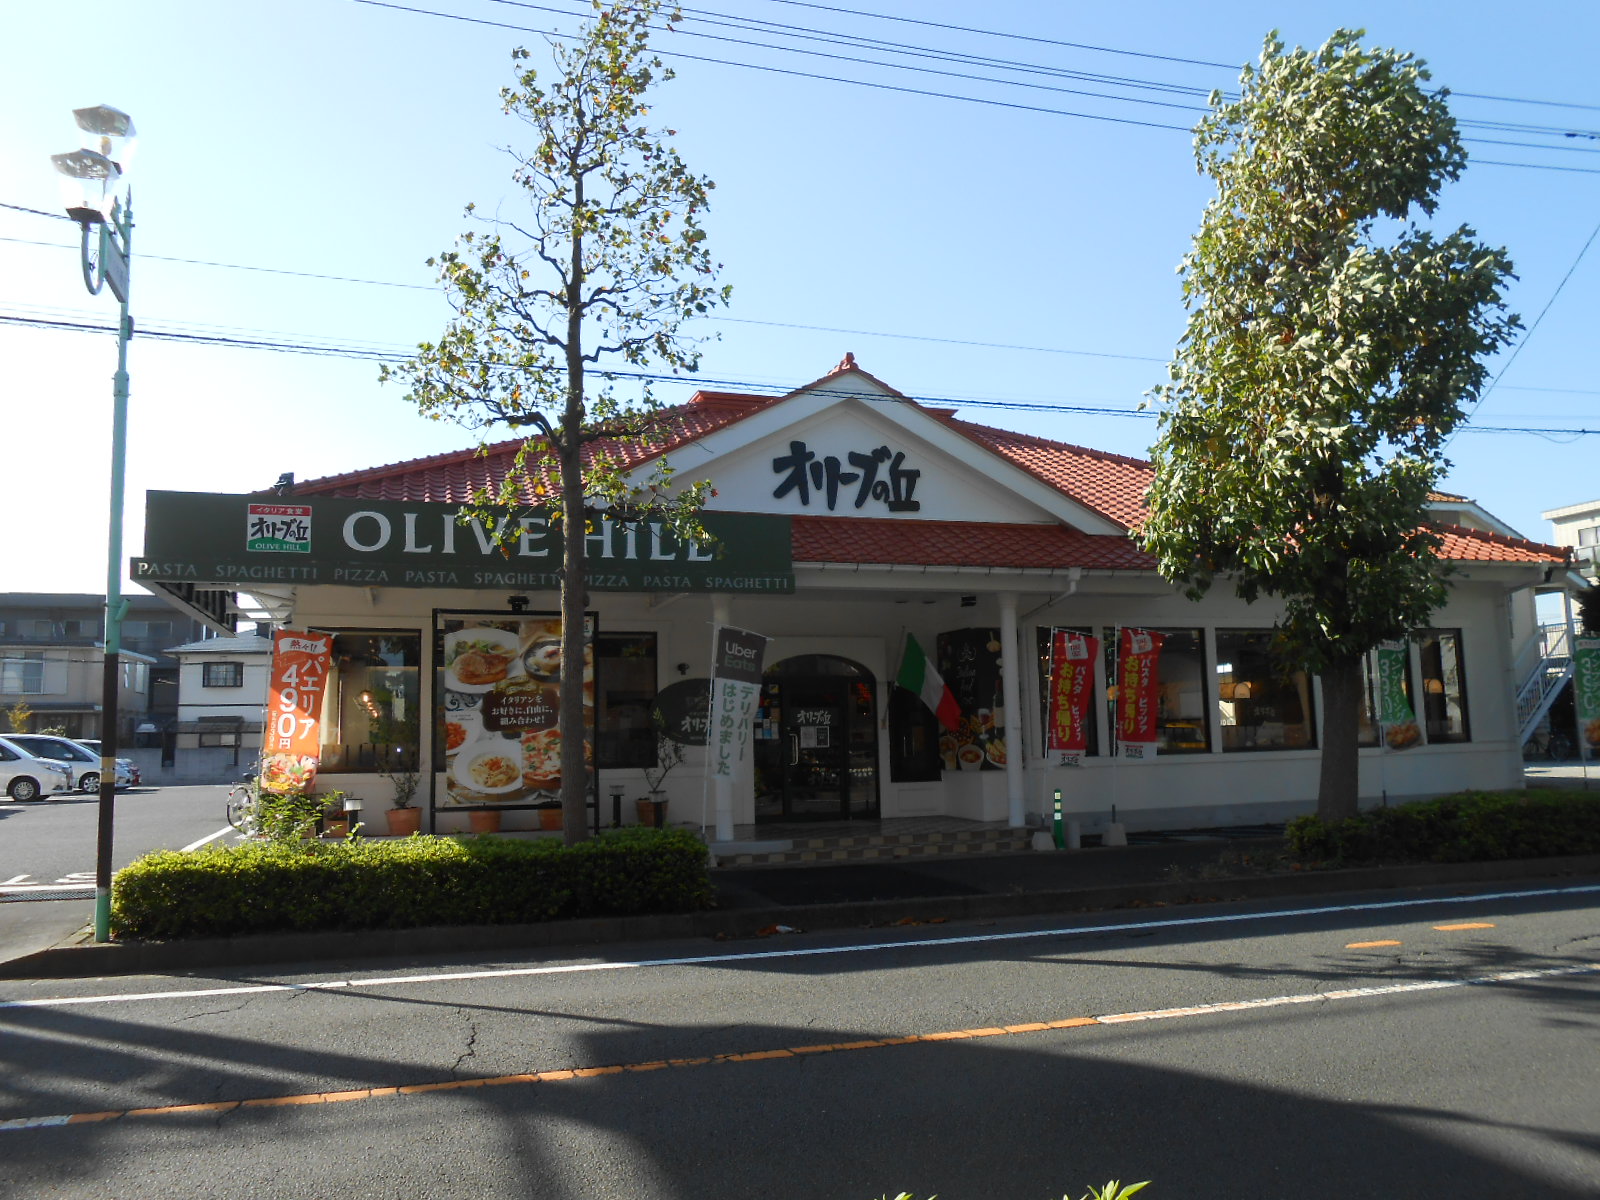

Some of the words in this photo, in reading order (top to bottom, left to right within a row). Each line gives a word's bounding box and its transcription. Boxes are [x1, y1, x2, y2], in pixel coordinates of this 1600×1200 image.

[773, 440, 921, 512] オリーブの丘
[250, 517, 309, 541] オリーブの丘
[342, 511, 549, 557] OLIVE
[255, 542, 280, 550] OLIVE
[137, 562, 197, 577] PASTA
[215, 565, 317, 580] SPAGHETTI
[334, 568, 390, 583] PIZZA
[405, 570, 459, 584] PASTA
[474, 571, 563, 585] SPAGHETT
[643, 576, 692, 588] PASTA
[705, 576, 788, 590] SPAGHETTI
[725, 640, 758, 659] Uber
[724, 655, 757, 673] Eats
[300, 655, 325, 740] パエリア
[501, 695, 542, 705] イタリアンを
[717, 682, 737, 776] はじめました
